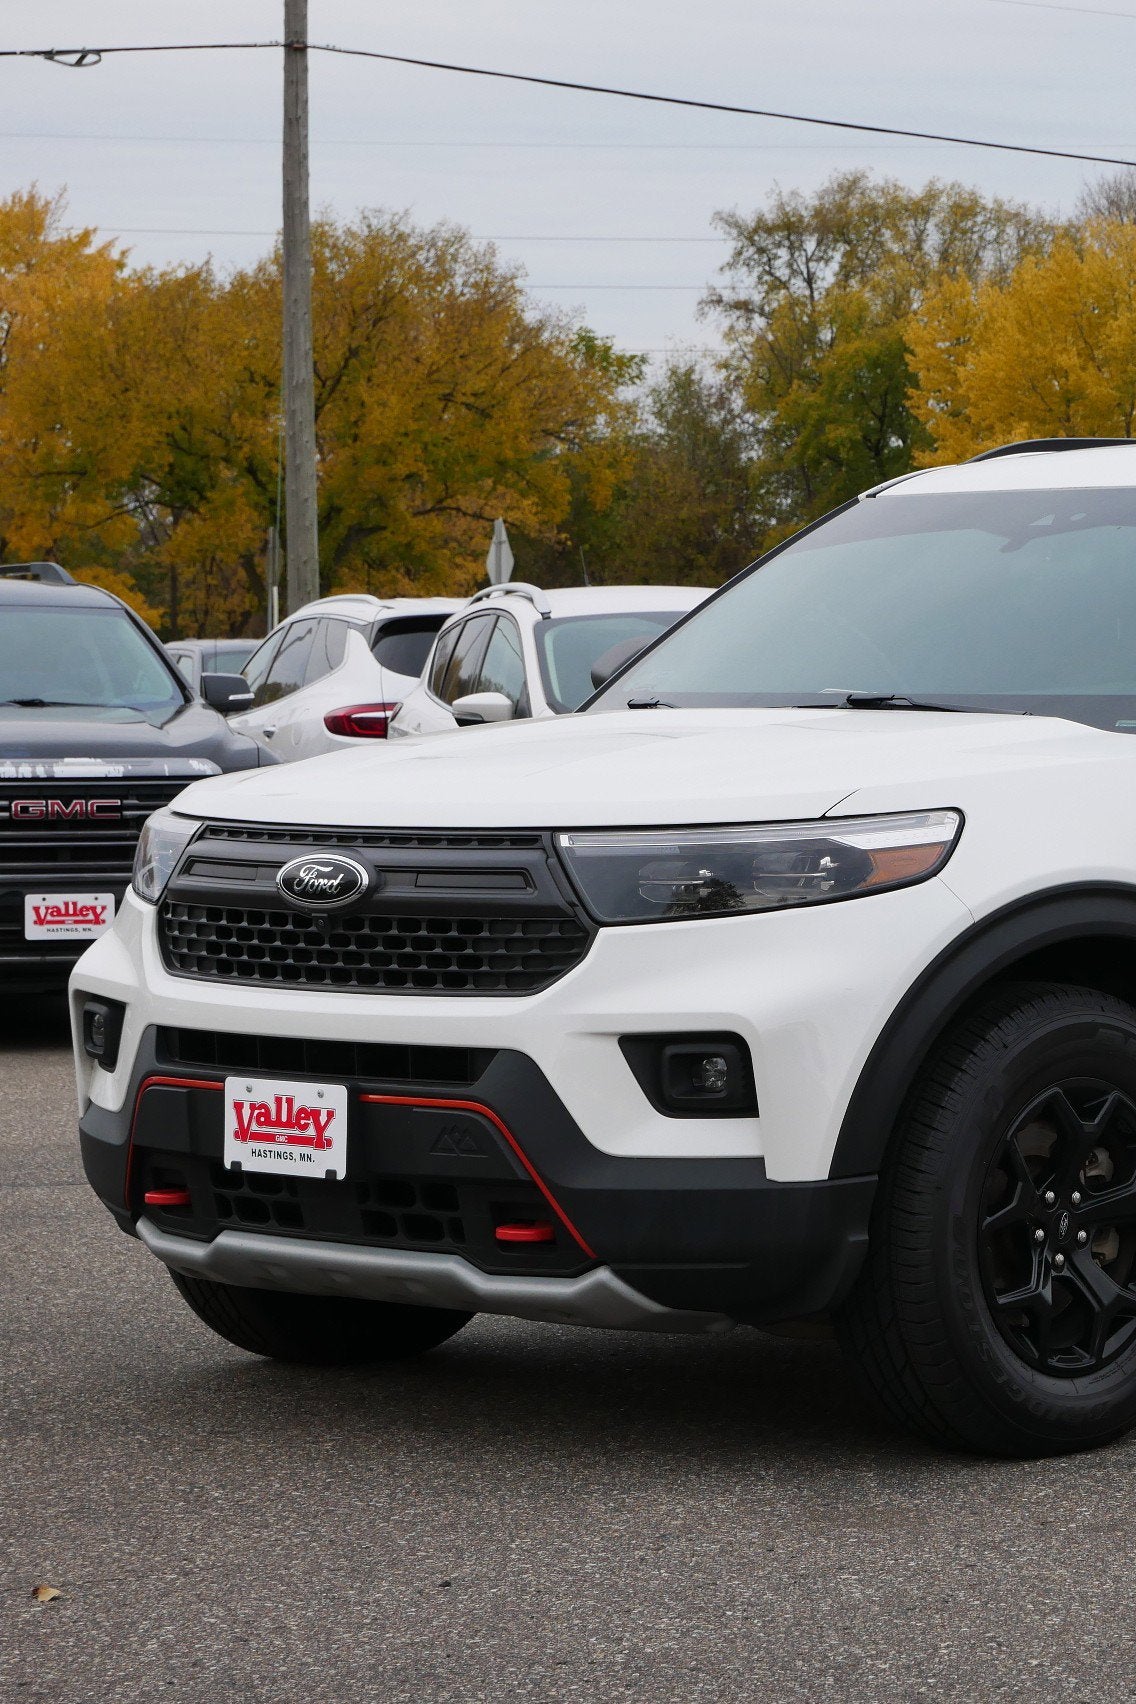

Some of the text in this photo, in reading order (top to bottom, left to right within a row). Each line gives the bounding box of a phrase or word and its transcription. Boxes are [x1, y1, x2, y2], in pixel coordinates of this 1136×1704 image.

[11, 800, 121, 819] GMC
[293, 864, 345, 894] Ford
[251, 1148, 315, 1163] HASTINGS, MN.
